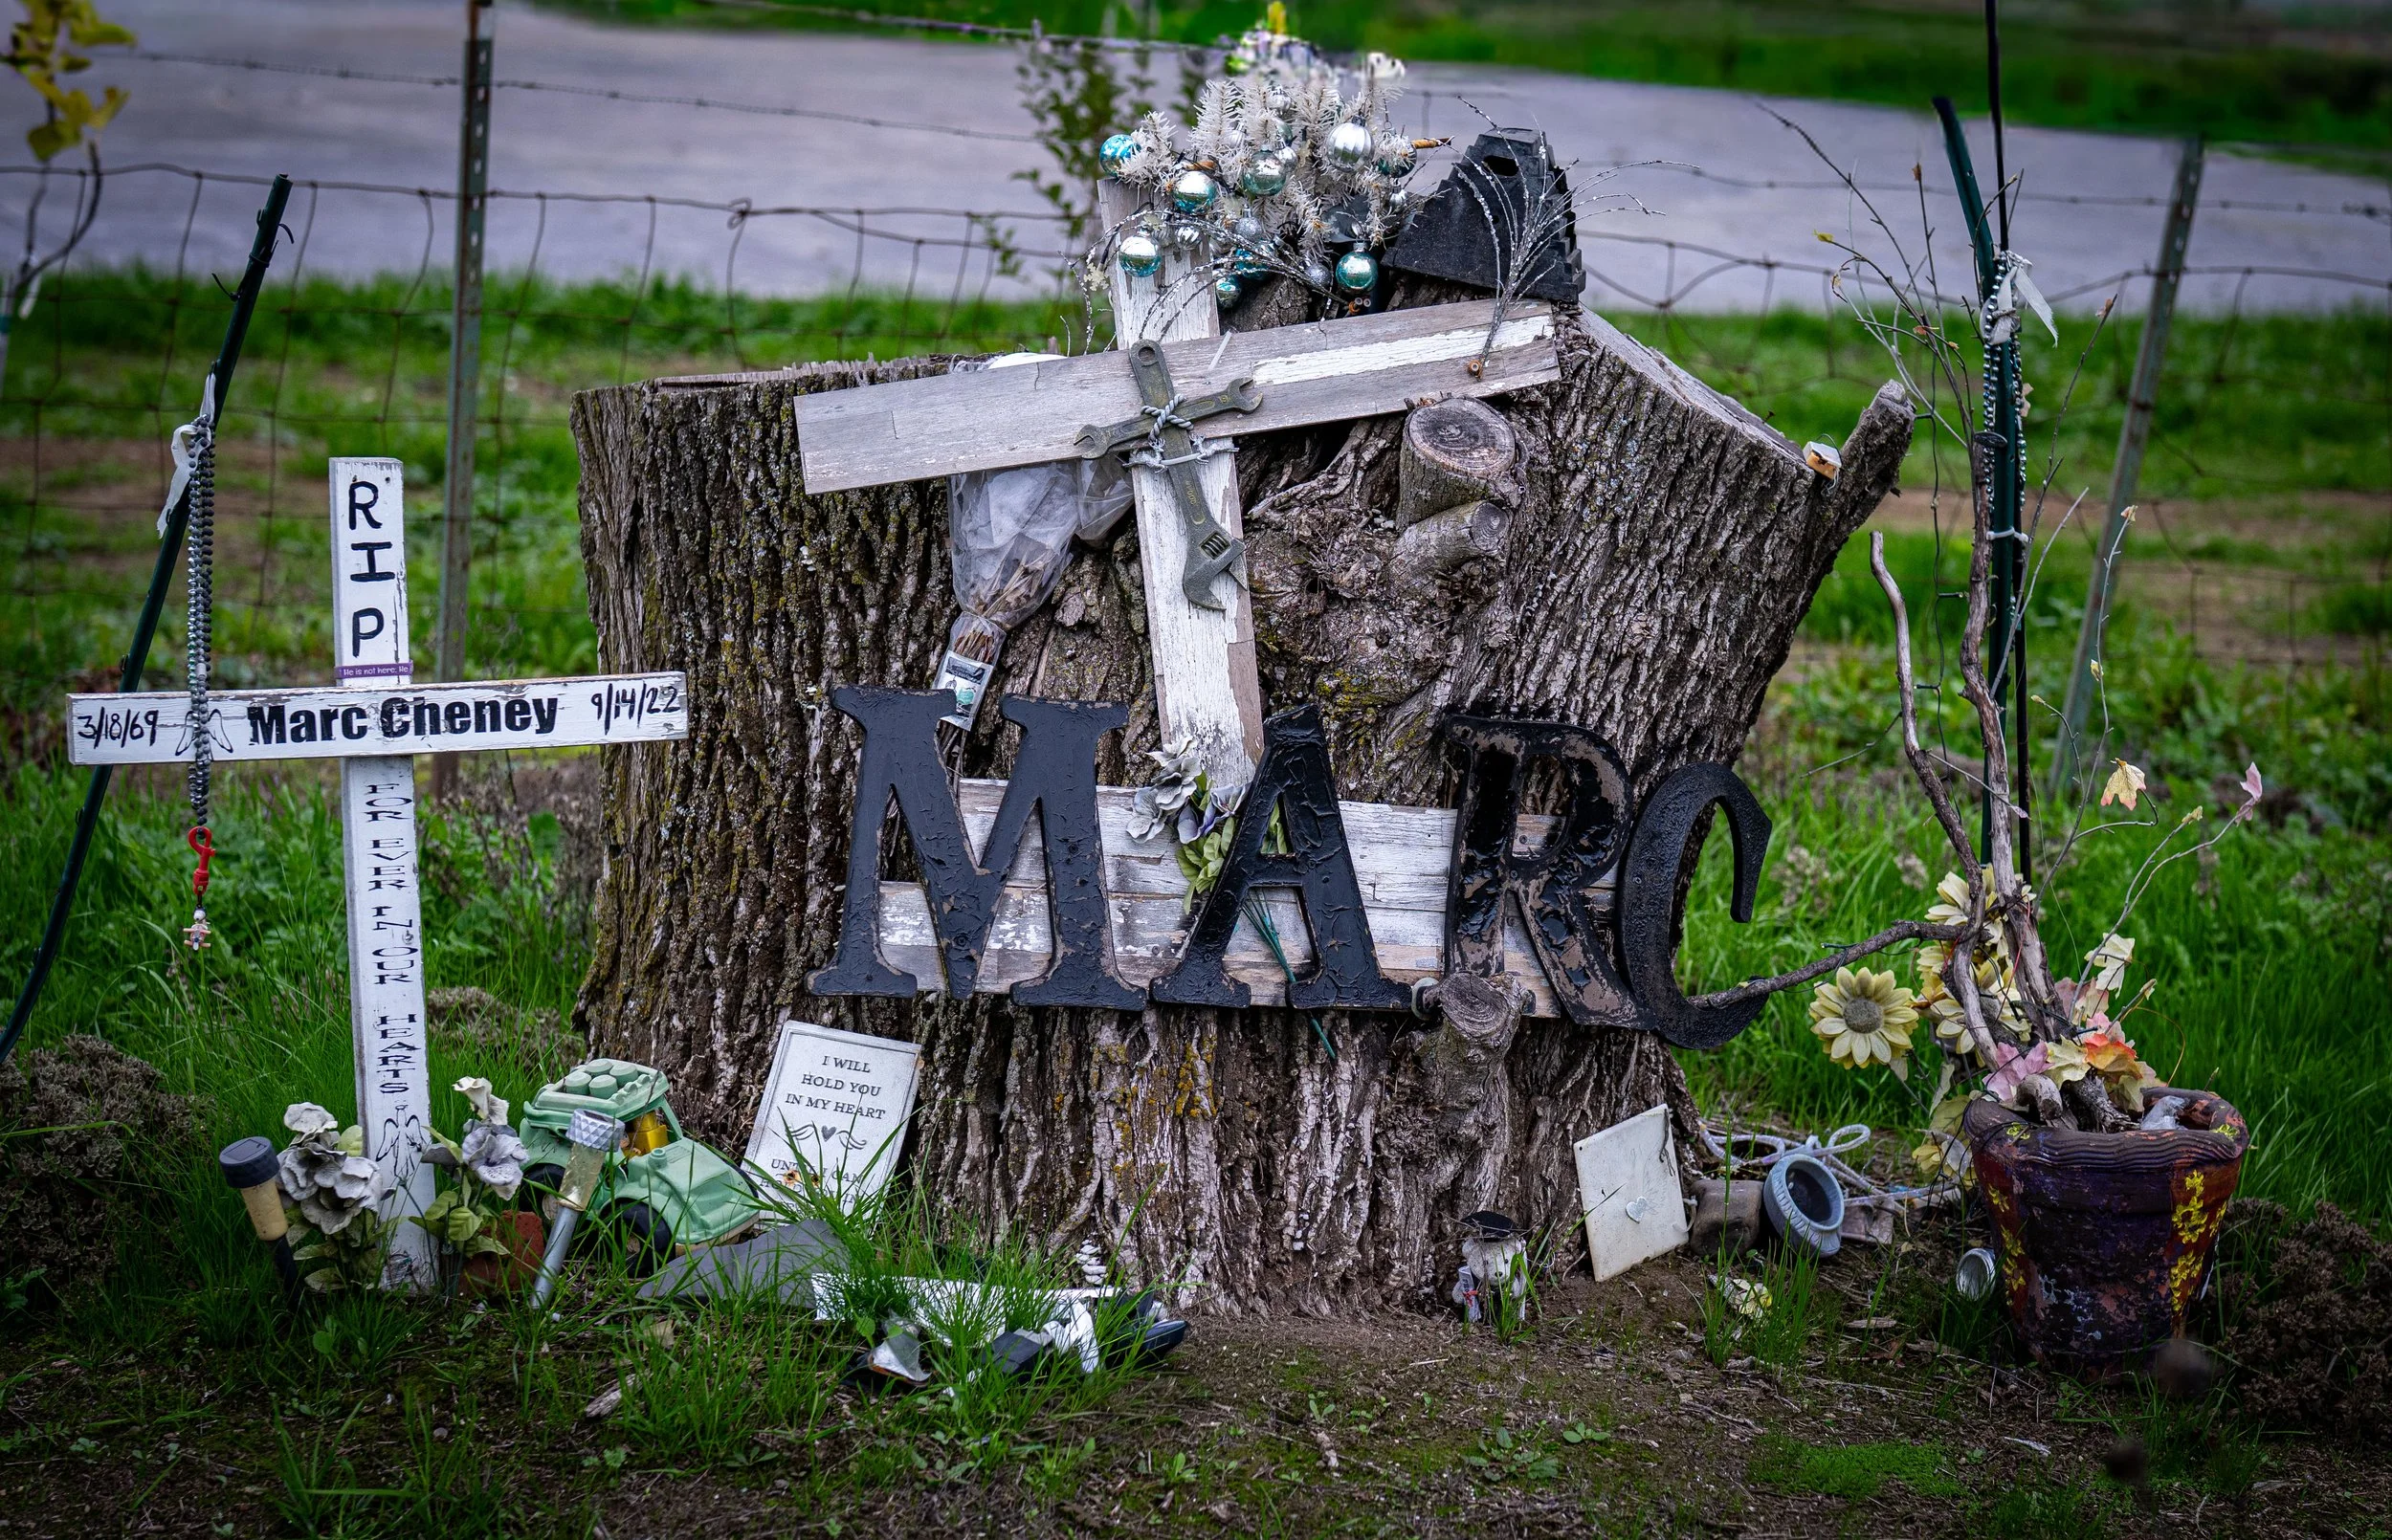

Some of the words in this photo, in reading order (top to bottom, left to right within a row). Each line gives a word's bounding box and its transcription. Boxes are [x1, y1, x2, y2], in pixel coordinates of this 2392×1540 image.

[349, 481, 396, 658] RIP
[78, 707, 159, 749] 3/18/69
[247, 704, 368, 746] Marc
[380, 696, 558, 738] Cheney
[590, 680, 681, 736] 9/14/22
[364, 783, 412, 823] FOR
[806, 685, 1772, 1050] MARC
[372, 946, 419, 985] OUR
[377, 1013, 421, 1094] HEARTS
[822, 1055, 828, 1066] I
[833, 1057, 871, 1073] WILL
[801, 1073, 844, 1090] HOLD
[850, 1082, 881, 1097] YOU
[785, 1093, 803, 1105] IN
[806, 1096, 832, 1110] MY
[832, 1101, 886, 1120] HEART
